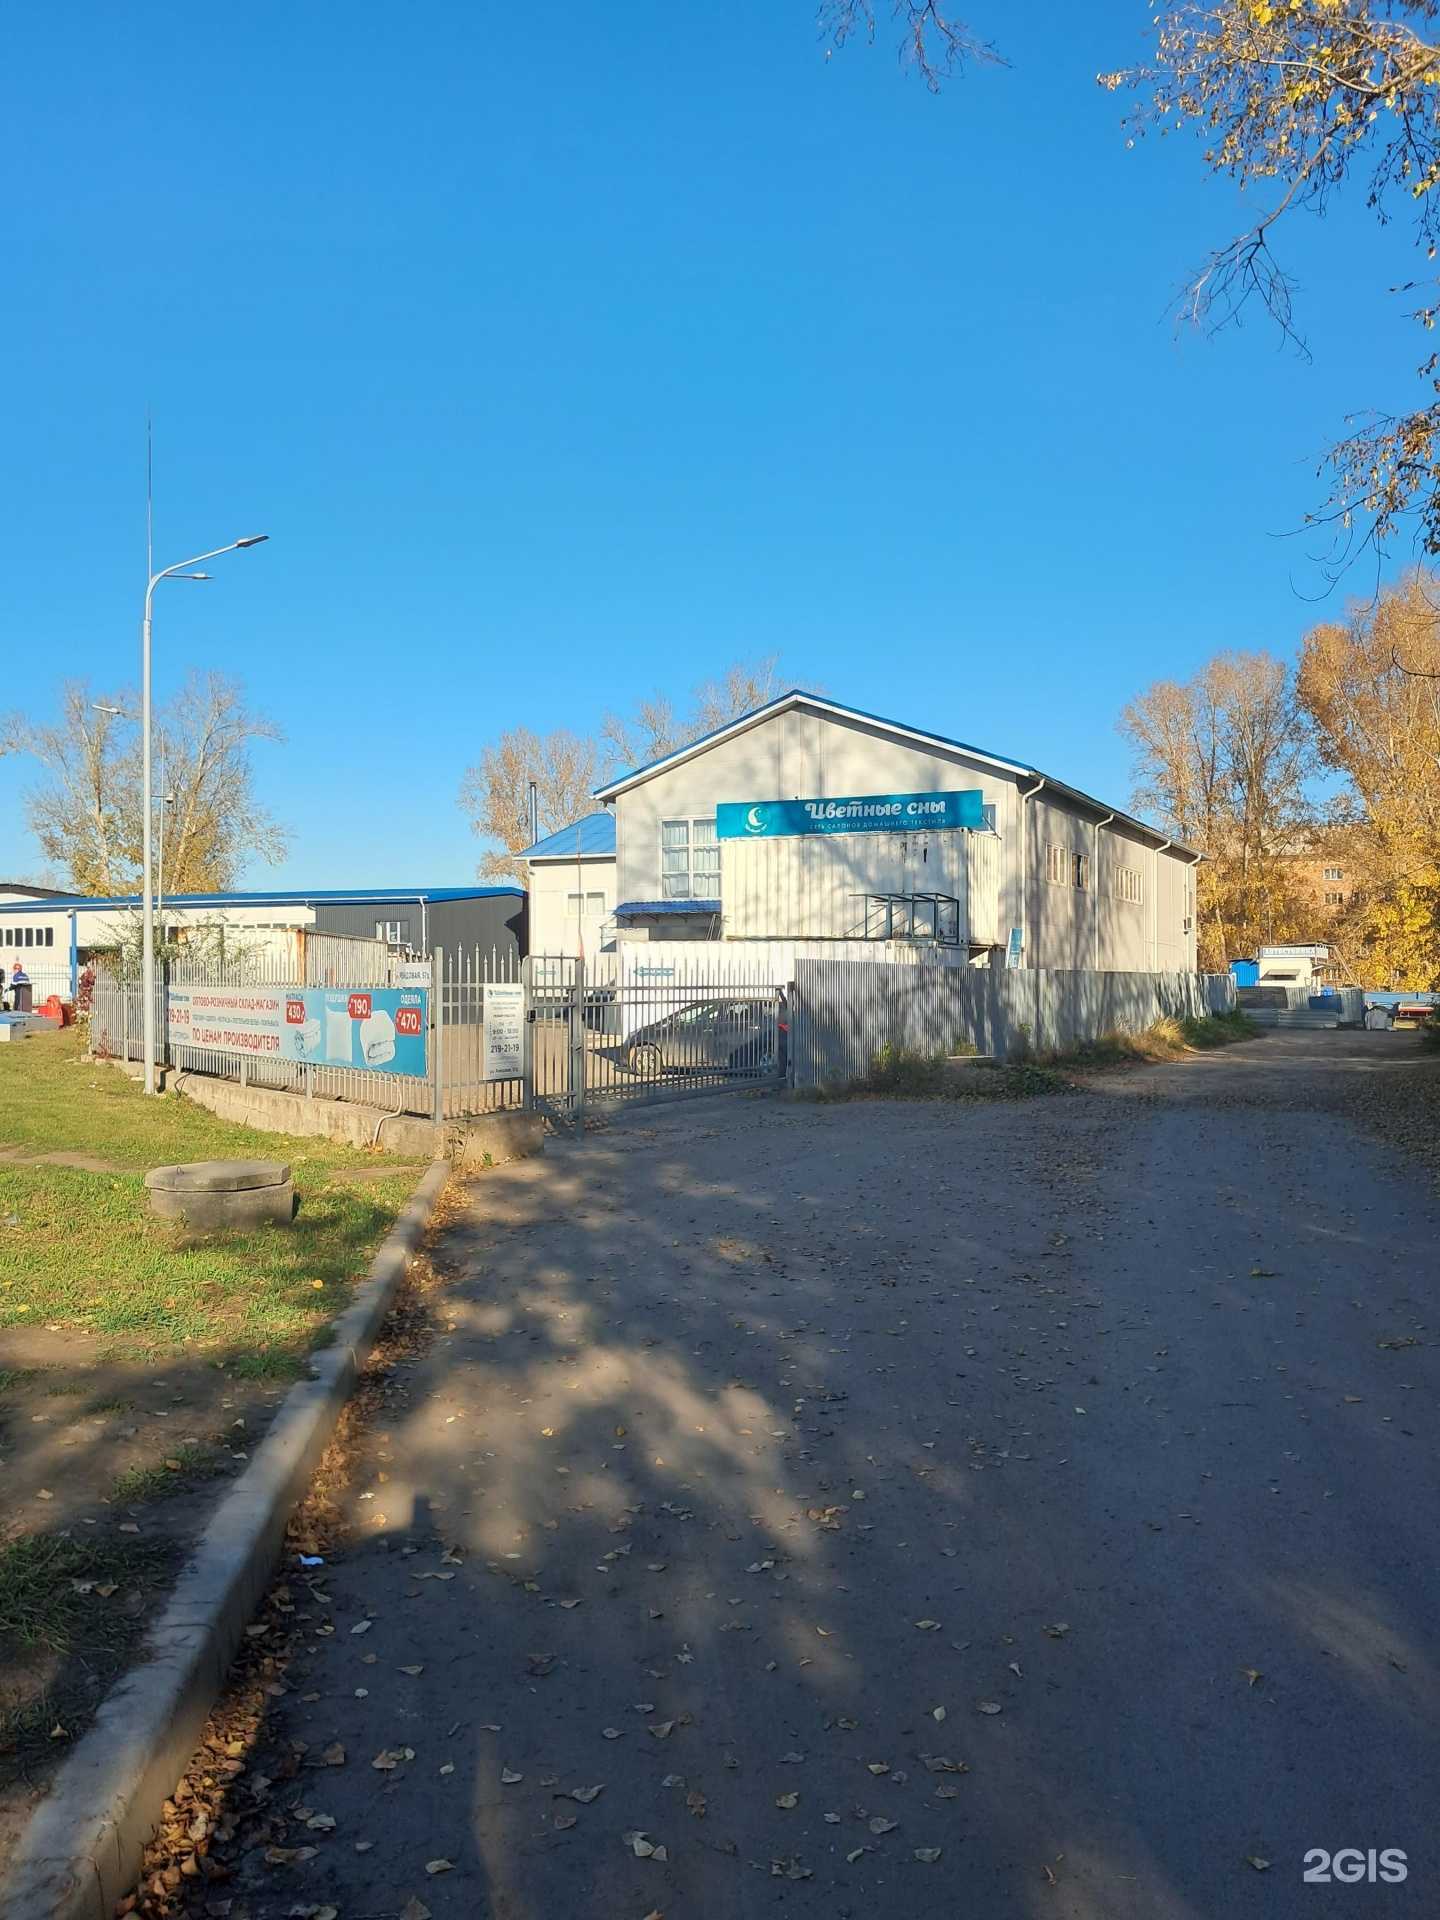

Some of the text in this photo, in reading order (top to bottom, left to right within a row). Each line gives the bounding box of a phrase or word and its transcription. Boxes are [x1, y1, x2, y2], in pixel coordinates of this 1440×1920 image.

[804, 800, 946, 820] Цветные сны
[826, 822, 861, 830] САЛОНОВ
[863, 819, 908, 829] ДОМАШНЕГО
[239, 997, 280, 1012] СКЛАД-МАГАЗИН
[287, 1004, 301, 1019] 430
[353, 999, 368, 1015] 190
[400, 1013, 417, 1030] 470
[192, 1027, 201, 1040] ПО
[202, 1029, 222, 1044] ЦЕНАМ
[223, 1031, 280, 1052] ПРОИЗВОДИТЕЛЯ
[490, 1043, 520, 1053] 219-21-19
